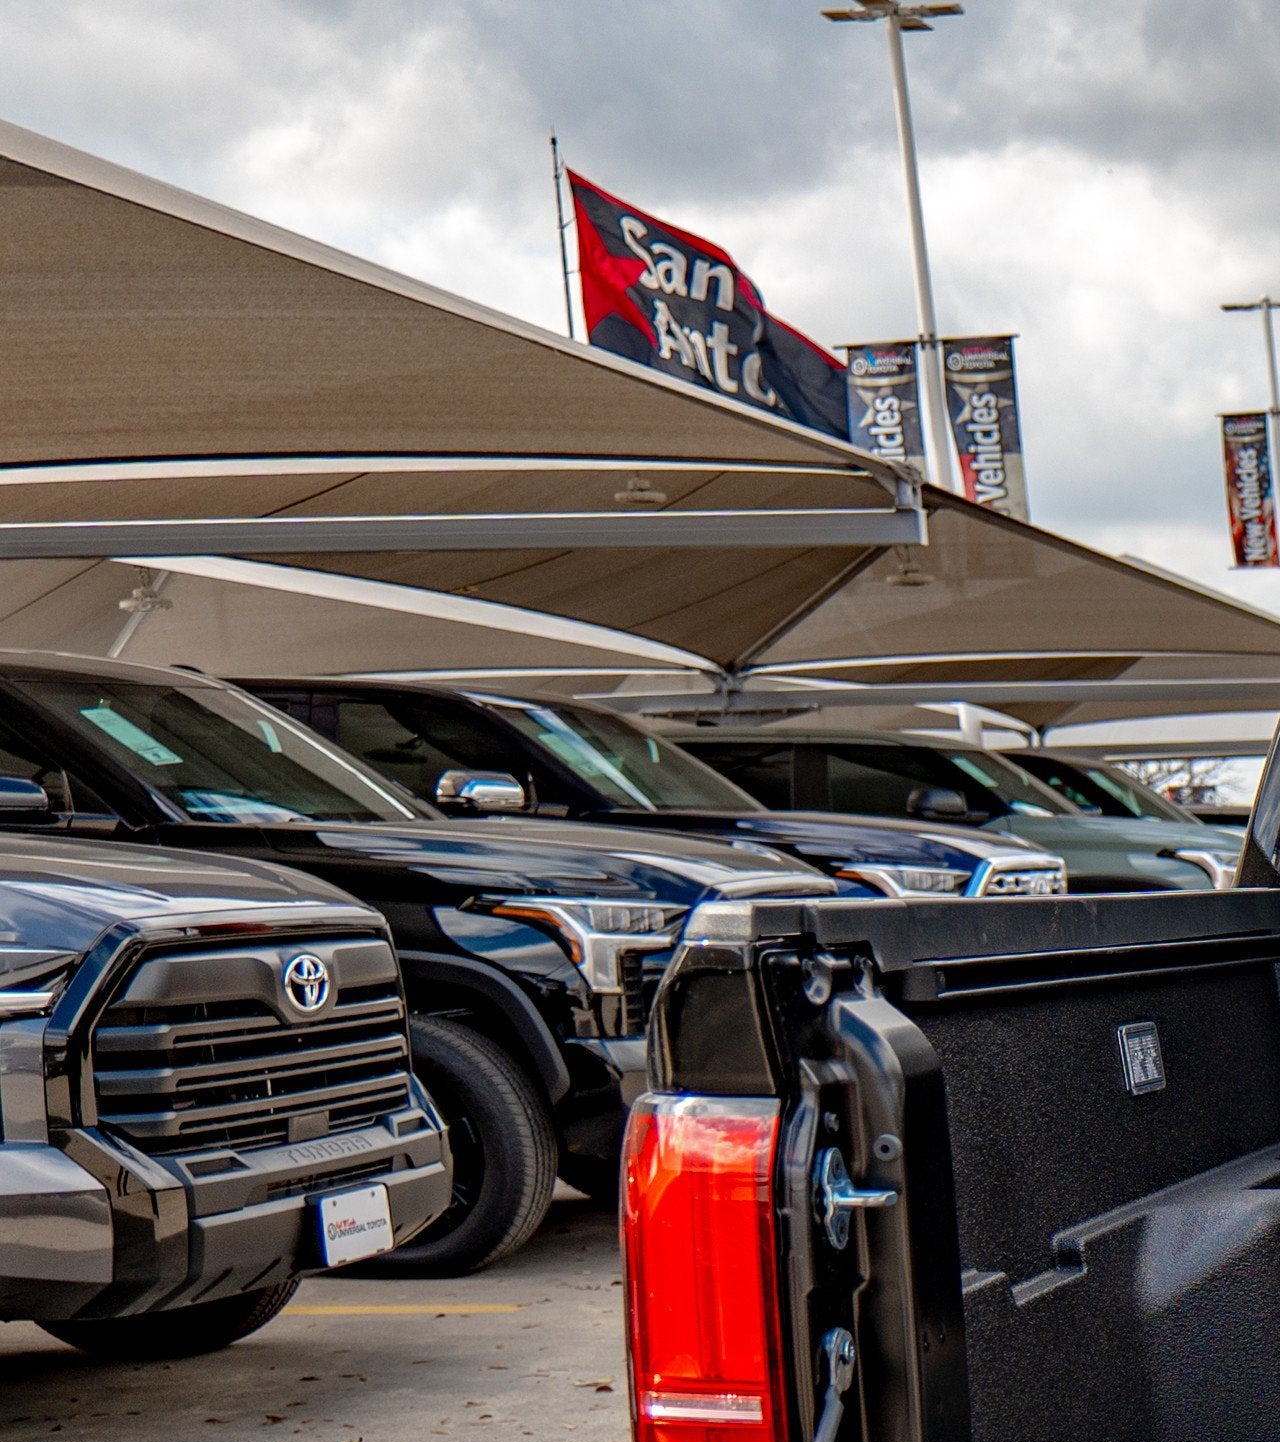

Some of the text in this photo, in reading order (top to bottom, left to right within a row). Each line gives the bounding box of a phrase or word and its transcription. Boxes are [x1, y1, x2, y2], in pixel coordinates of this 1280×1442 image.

[620, 215, 734, 312] San
[868, 395, 906, 462] icles
[966, 392, 1008, 504] Vehicles
[1235, 447, 1262, 520] Vehicles
[279, 1136, 372, 1163] TUNDRA
